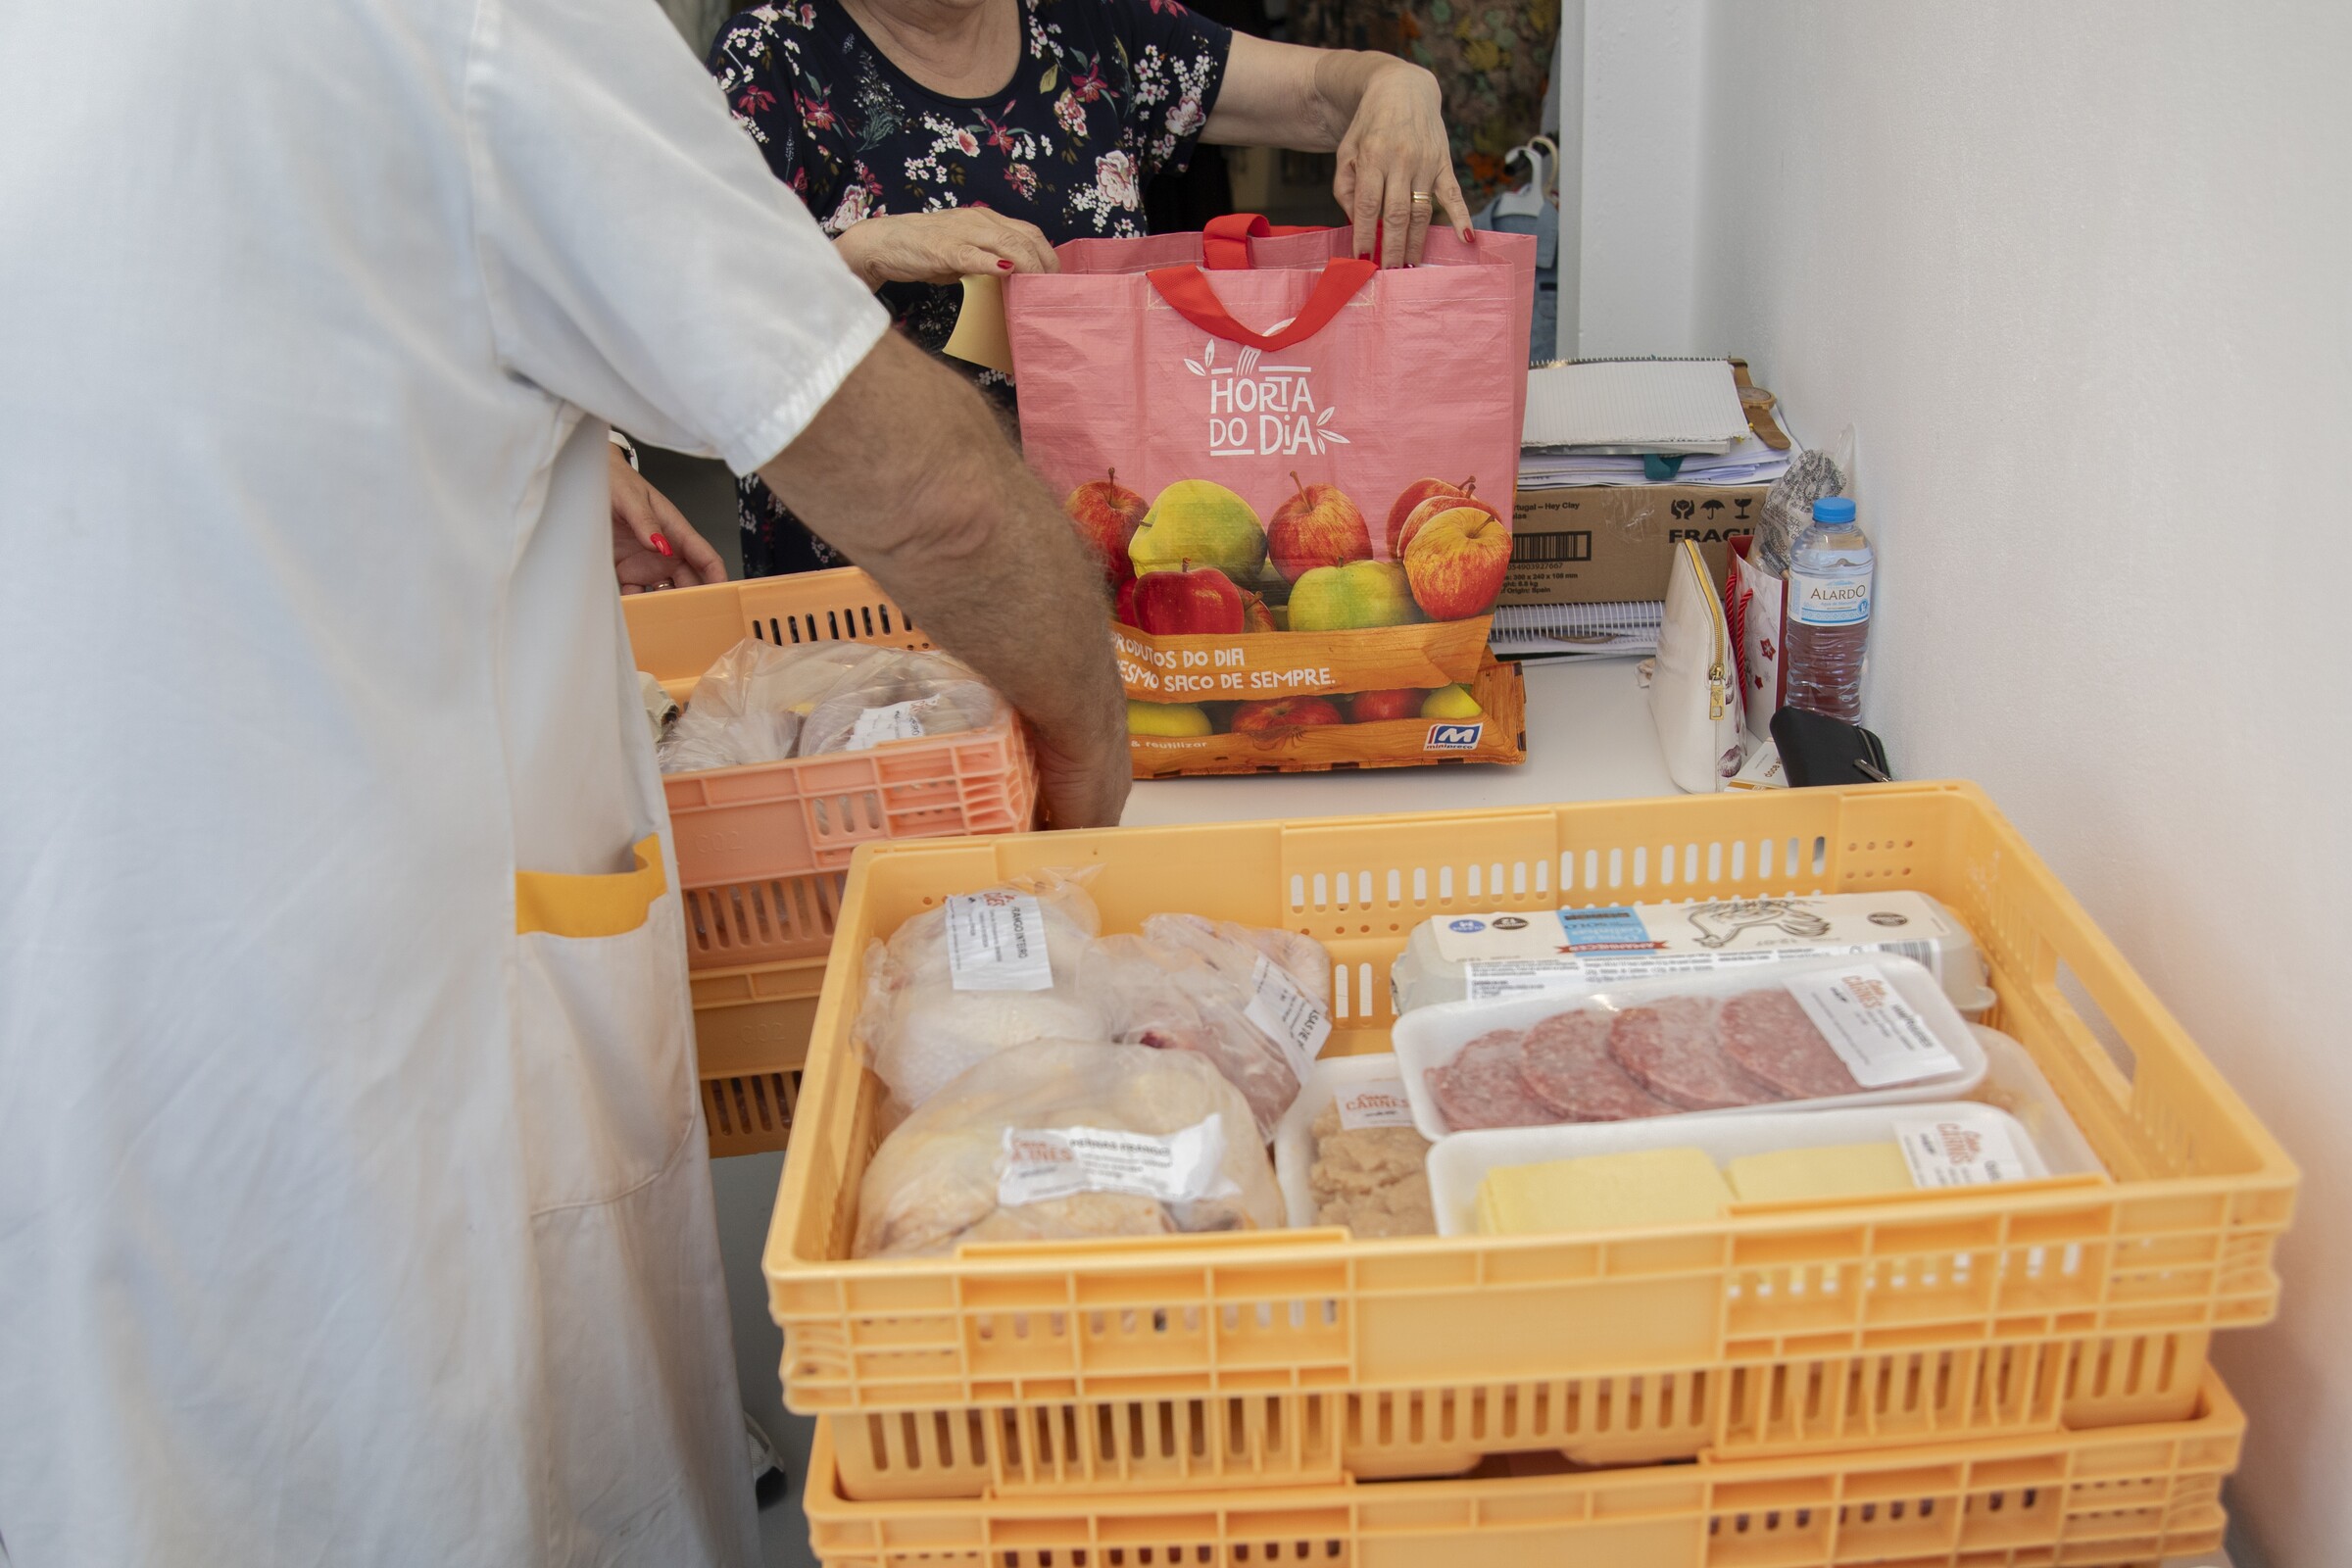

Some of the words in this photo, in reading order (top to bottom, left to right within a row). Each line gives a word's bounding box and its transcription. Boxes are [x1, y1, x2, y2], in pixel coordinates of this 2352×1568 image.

[1210, 376, 1315, 414] HORTA
[1209, 417, 1248, 447] DO
[1669, 528, 1755, 543] FRAGI
[1810, 584, 1866, 601] ALARDO
[1183, 651, 1208, 667] DO
[1214, 648, 1245, 667] DIA
[1117, 660, 1158, 689] ESMO
[1164, 673, 1214, 692] SACO
[1220, 672, 1244, 689] DE
[1250, 667, 1336, 689] SEMPRE.
[1145, 741, 1207, 750] reutilizar
